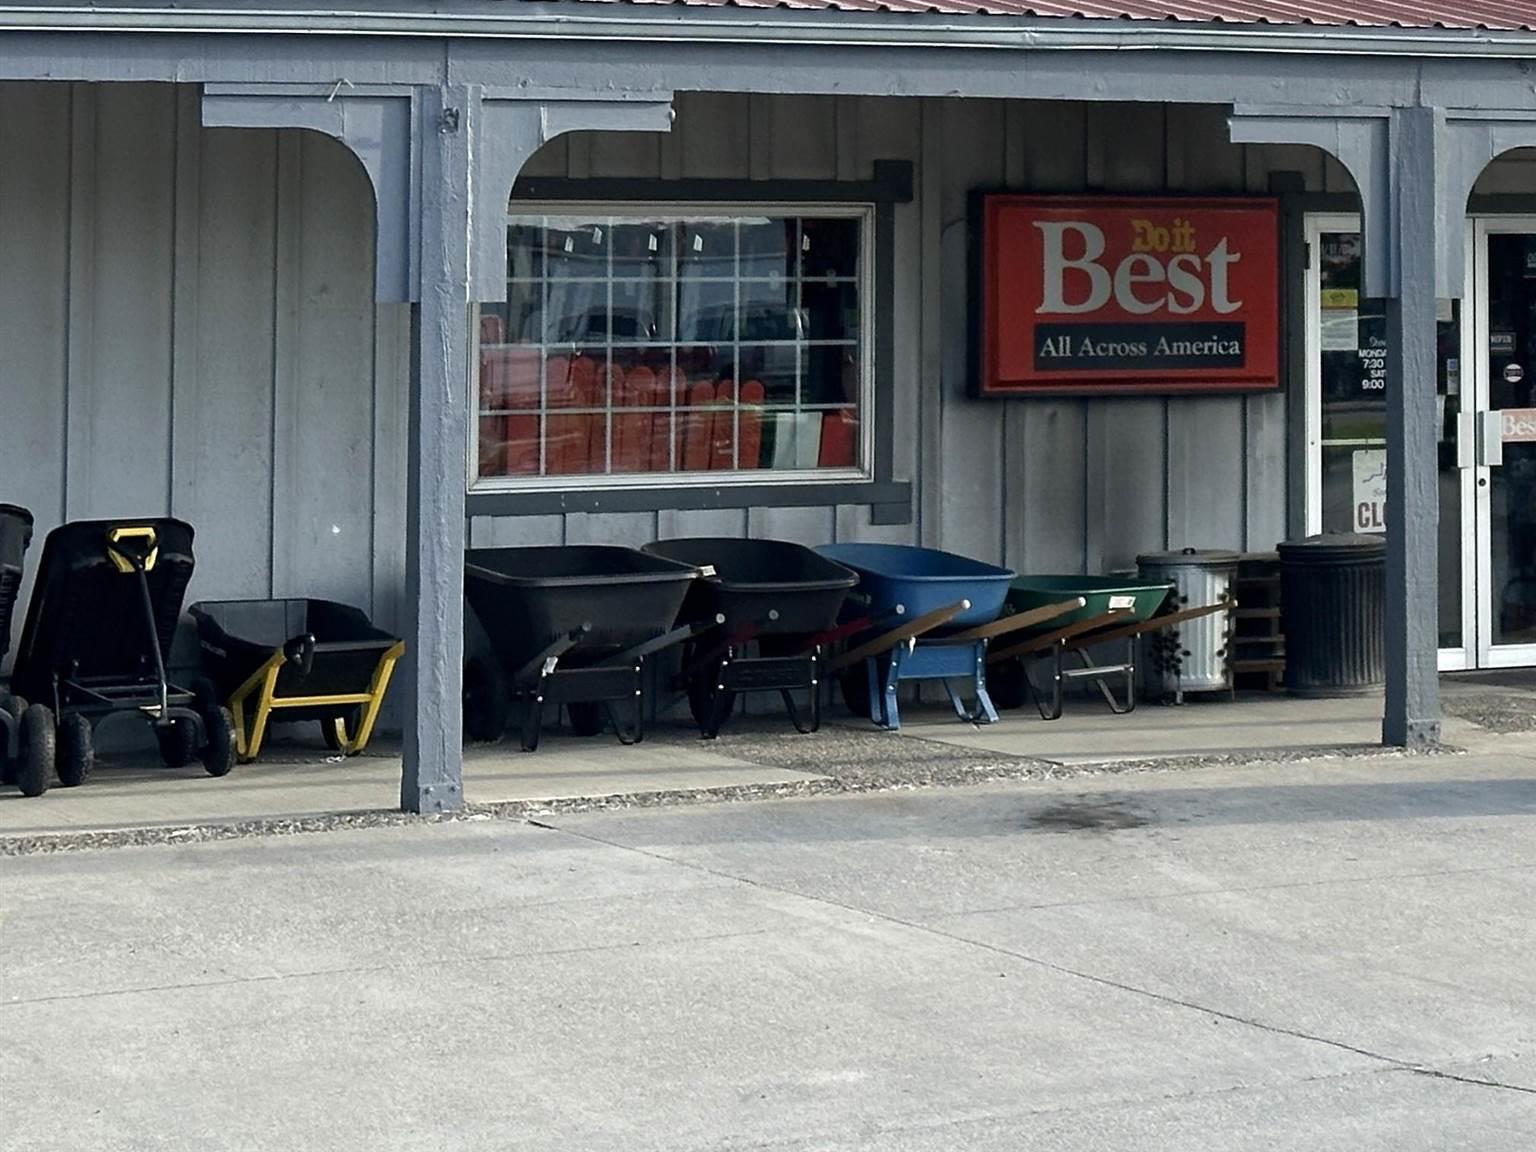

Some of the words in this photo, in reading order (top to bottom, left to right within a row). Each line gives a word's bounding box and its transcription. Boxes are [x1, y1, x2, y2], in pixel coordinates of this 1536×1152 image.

[1130, 219, 1169, 252] Do
[1172, 217, 1196, 252] it
[1032, 221, 1243, 315] Best
[1039, 335, 1073, 358] All
[1077, 336, 1148, 357] Across
[1152, 335, 1241, 356] America
[1358, 349, 1387, 357] MONDA
[1362, 358, 1384, 369] 7:30
[1361, 379, 1385, 390] 9:00
